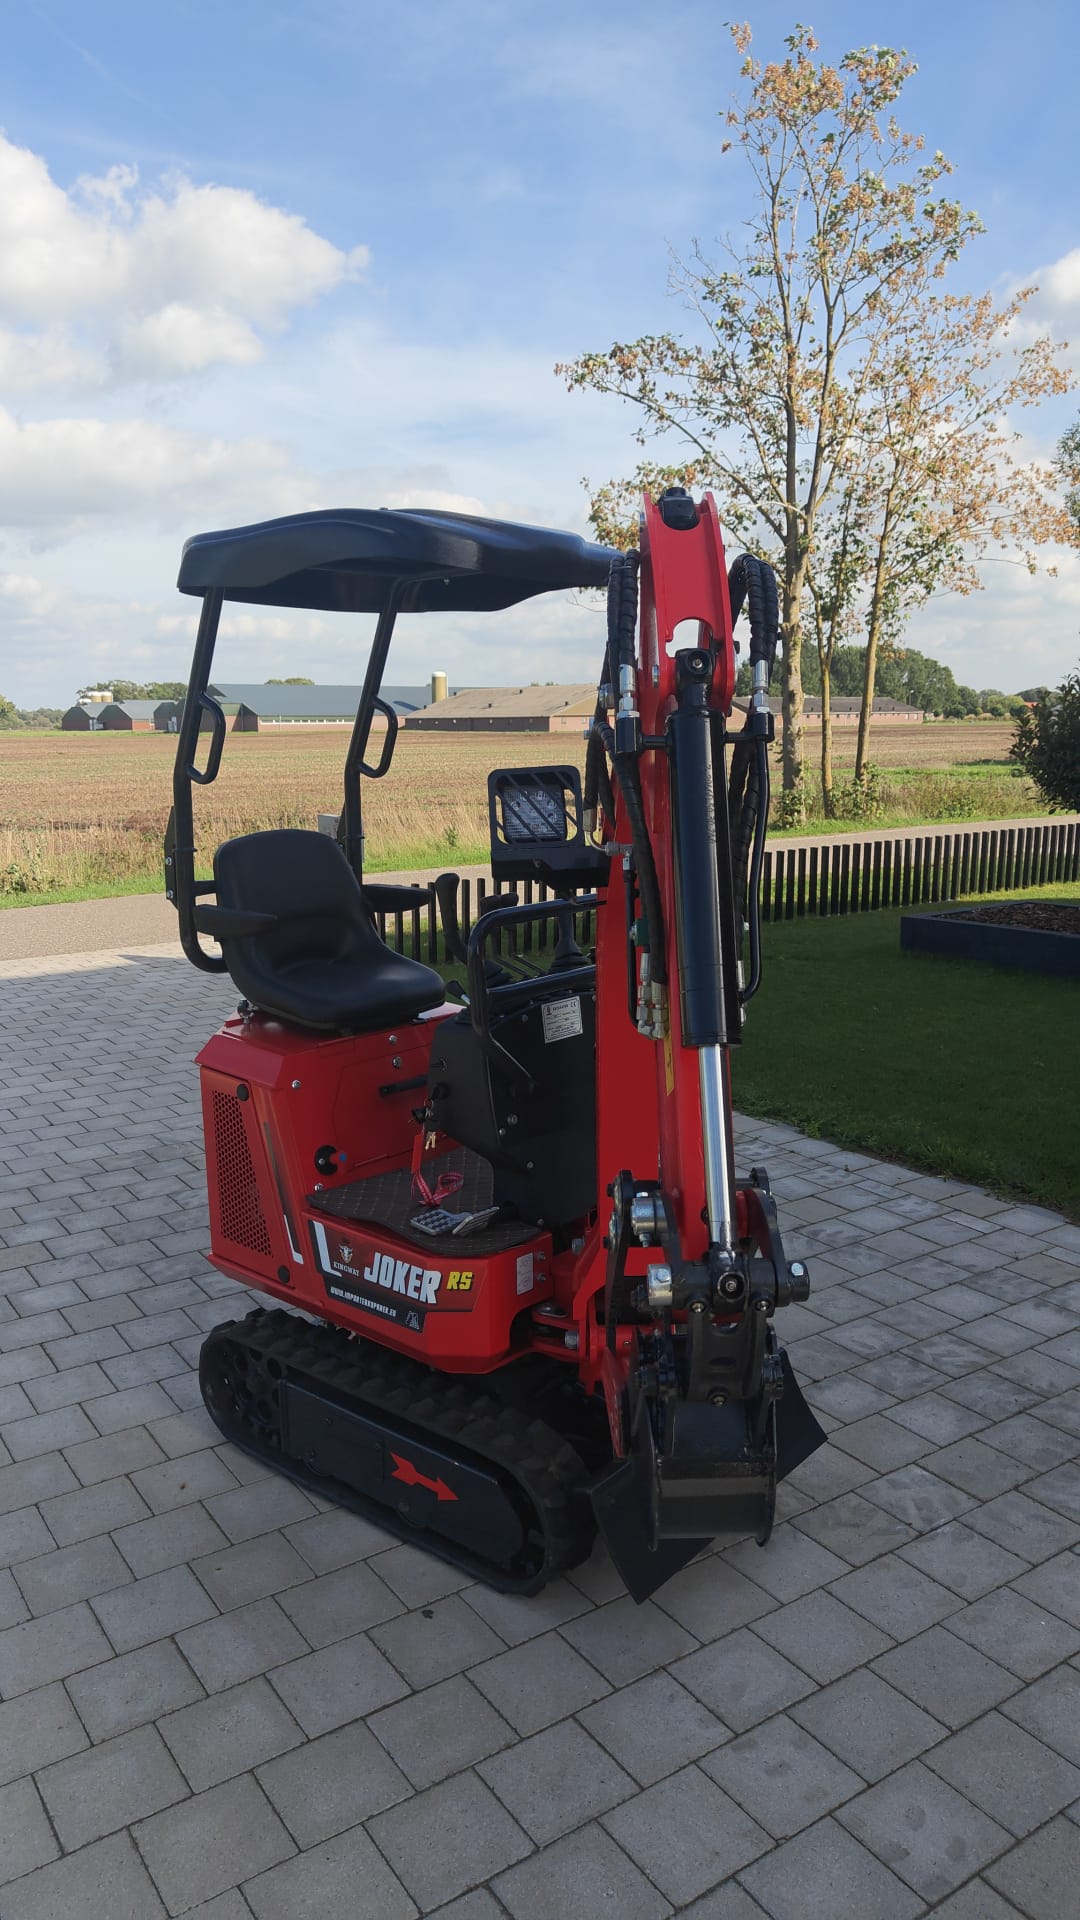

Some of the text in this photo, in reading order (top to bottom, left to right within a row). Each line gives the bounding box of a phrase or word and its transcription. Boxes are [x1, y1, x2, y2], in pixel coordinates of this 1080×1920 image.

[333, 1261, 360, 1277] KINGWAY
[363, 1252, 473, 1304] JOKER RS
